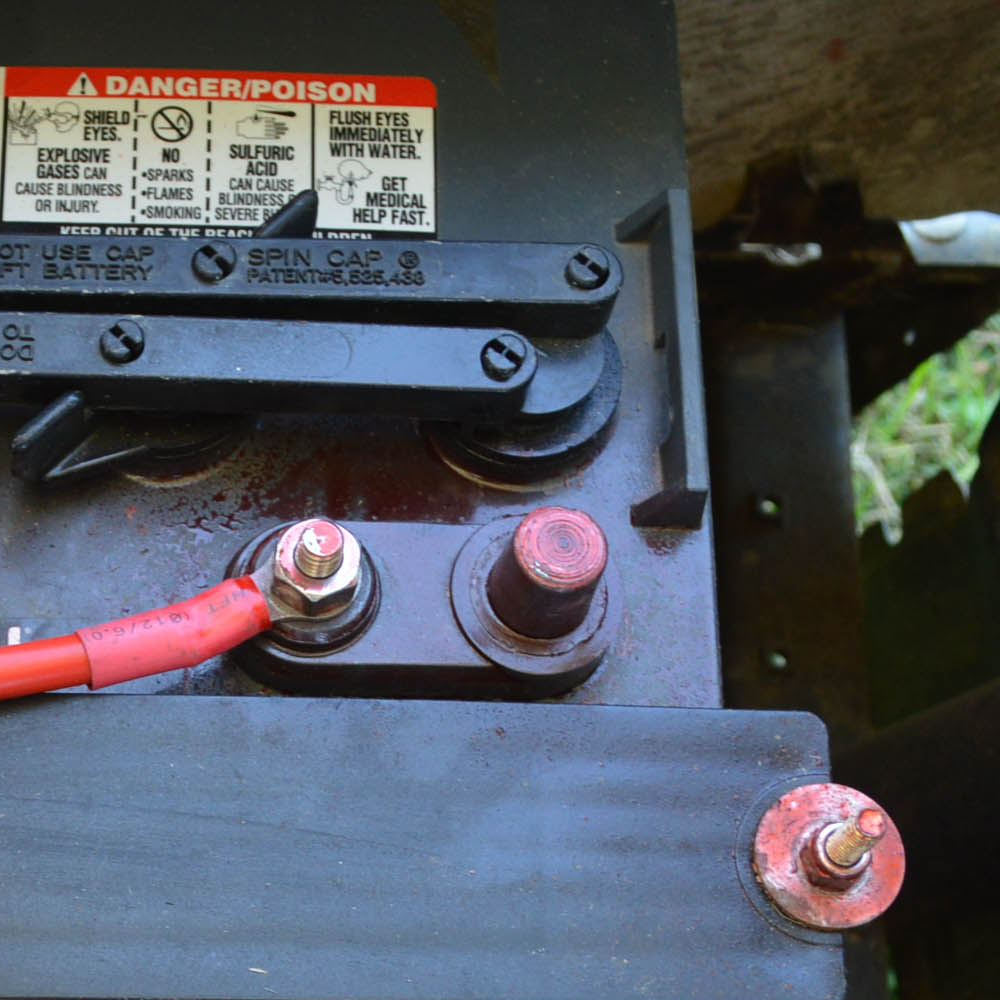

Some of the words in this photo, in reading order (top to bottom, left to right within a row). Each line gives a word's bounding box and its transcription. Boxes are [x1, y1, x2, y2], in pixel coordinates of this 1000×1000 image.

[105, 75, 376, 103] DANGER/POISON
[84, 110, 130, 125] SHIELD
[329, 110, 370, 125] FLUSH
[373, 112, 409, 127] EYES
[83, 126, 122, 141] EYES.
[329, 127, 424, 144] IMMEDIATELY
[37, 148, 110, 163] EXPLOSIVE
[162, 148, 180, 163] NO
[230, 144, 294, 160] SULFURIC
[329, 142, 364, 158] WITH
[369, 143, 421, 159] WATER.
[37, 164, 80, 179] GASES
[83, 167, 107, 179] CAN
[246, 162, 278, 176] ACID
[15, 182, 53, 195] CAUSE
[57, 183, 123, 196] BLINDNESS
[229, 178, 252, 191] CAN
[256, 178, 294, 191] CAUSE
[382, 176, 408, 191] GET
[35, 199, 52, 212] OR
[56, 200, 100, 213] INJURY.
[219, 192, 283, 206] BLINDNESS
[366, 192, 426, 209] MEDICAL
[215, 207, 259, 221] SEVERE
[353, 208, 387, 224] HELP
[391, 210, 430, 226] FAST.
[41, 245, 92, 262] USE
[105, 245, 155, 262] CAP
[247, 248, 312, 267] SPIN
[327, 249, 383, 269] CAP
[42, 263, 154, 281] BATTERY
